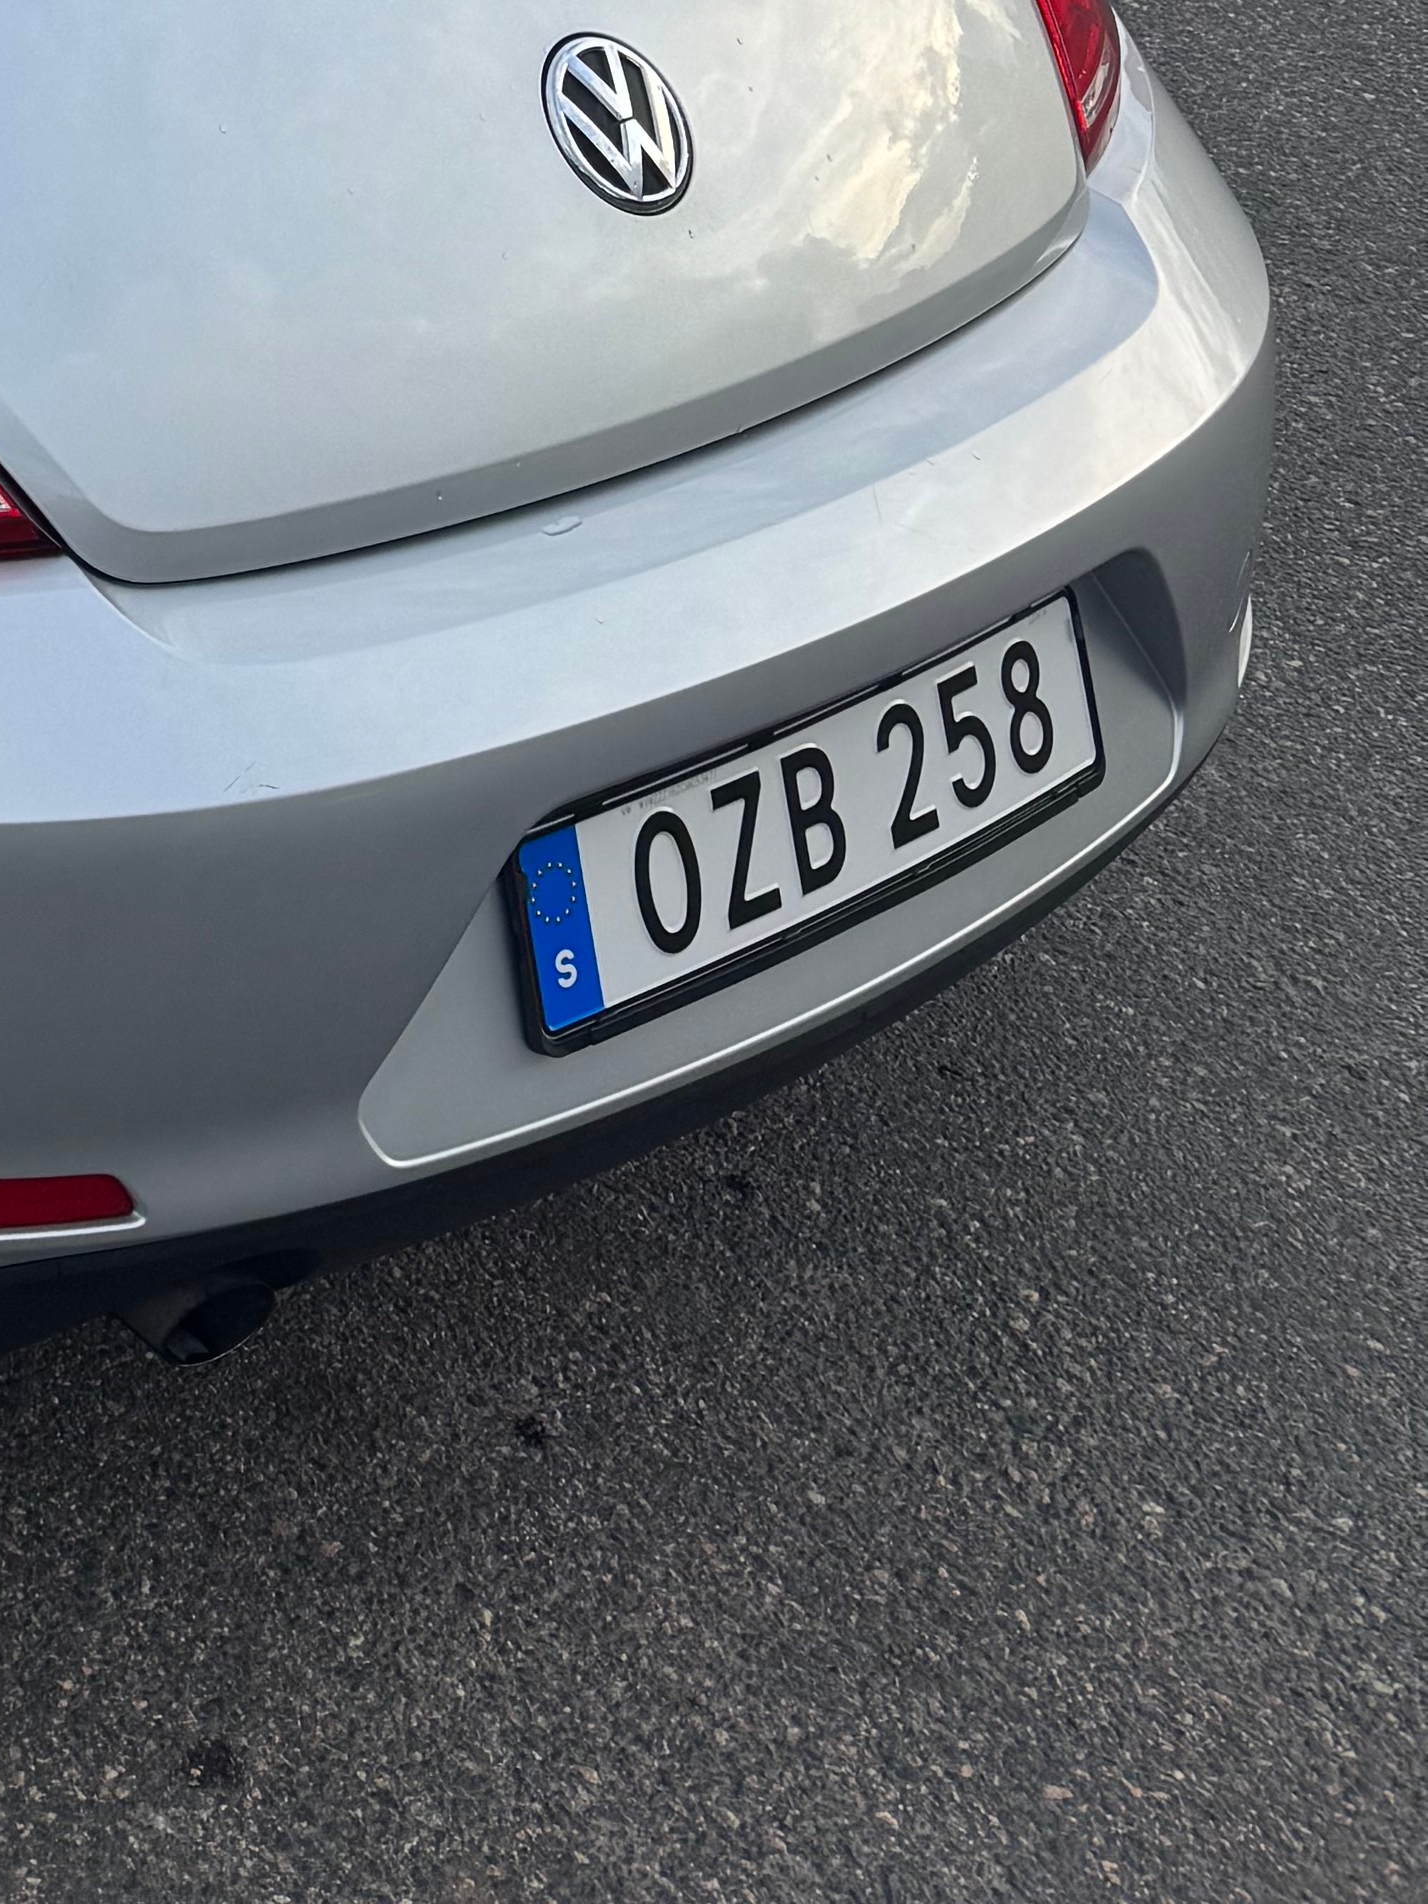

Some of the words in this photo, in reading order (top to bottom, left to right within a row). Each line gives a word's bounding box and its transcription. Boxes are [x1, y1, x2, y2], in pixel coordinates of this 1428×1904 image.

[634, 742, 847, 955] OZB
[876, 640, 1054, 850] 258
[555, 949, 578, 989] S
